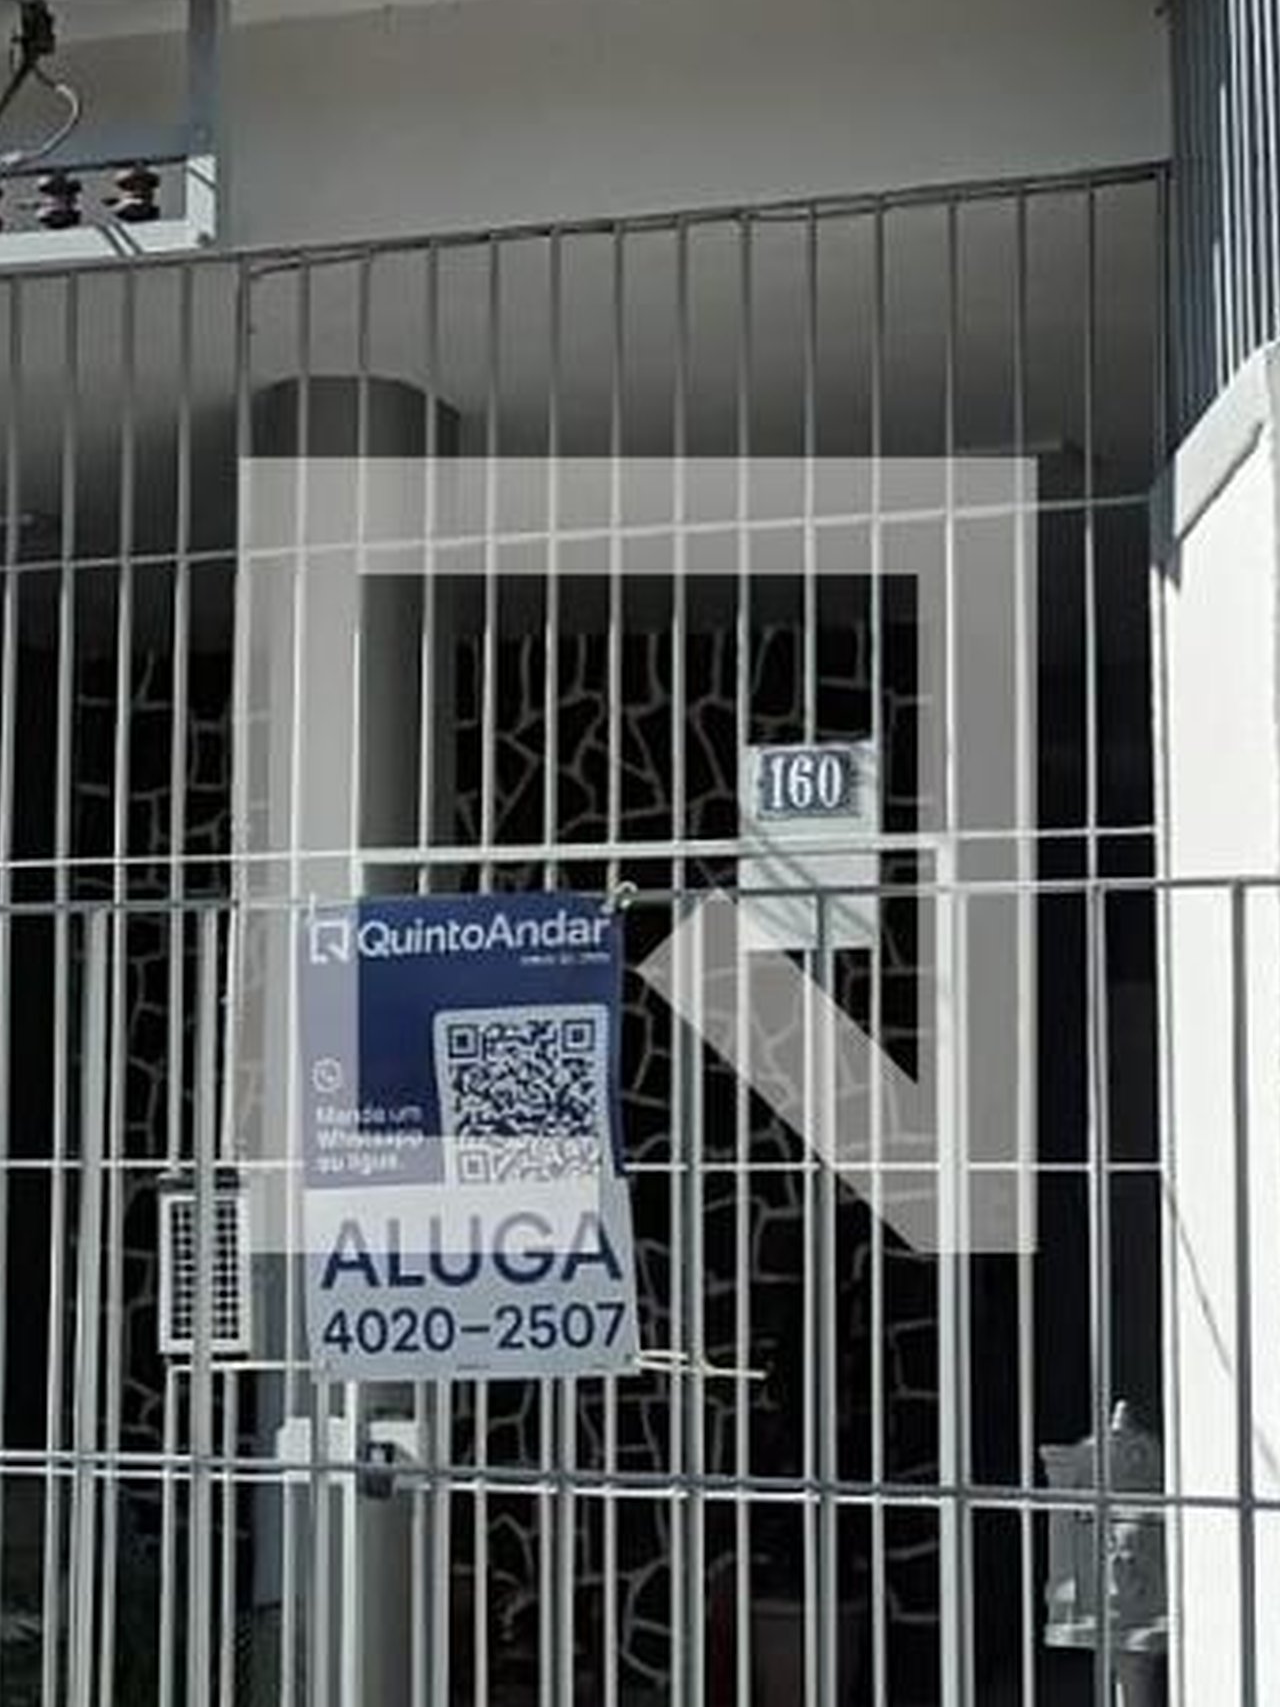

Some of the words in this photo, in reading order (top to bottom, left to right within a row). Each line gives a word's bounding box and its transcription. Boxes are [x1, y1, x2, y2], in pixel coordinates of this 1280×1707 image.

[771, 754, 842, 809] 160
[357, 909, 611, 957] QuintoAndar
[320, 1212, 622, 1289] ALUGA
[322, 1303, 626, 1355] 4020-2507
